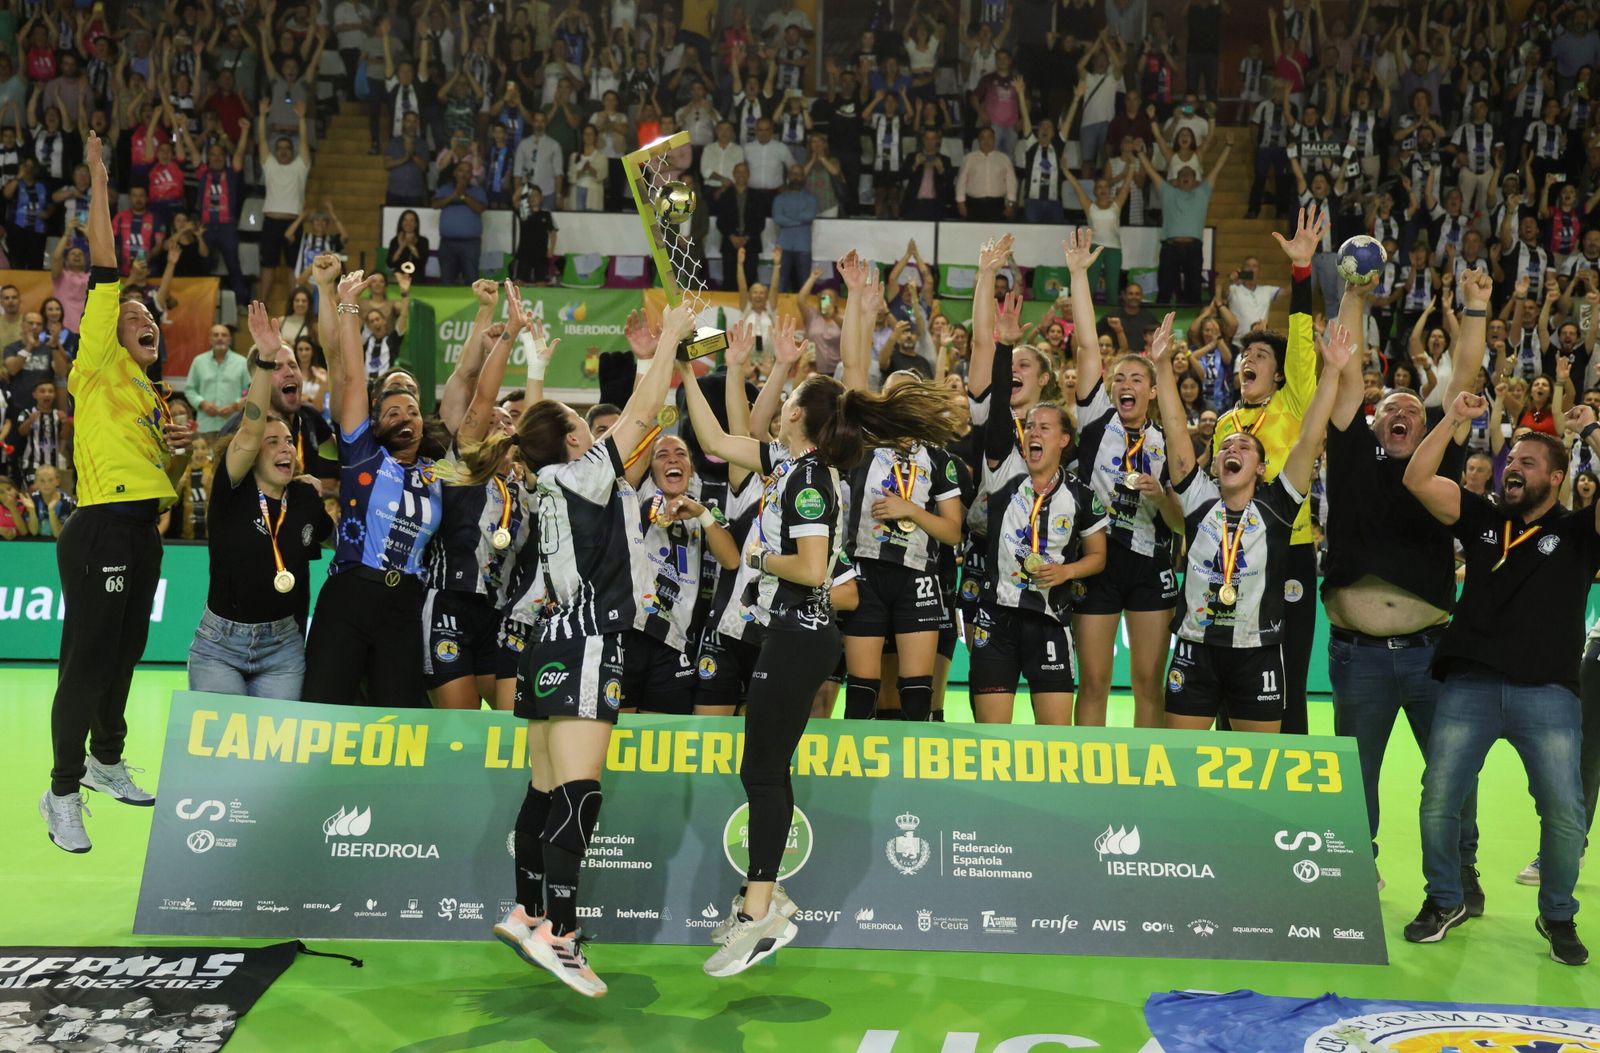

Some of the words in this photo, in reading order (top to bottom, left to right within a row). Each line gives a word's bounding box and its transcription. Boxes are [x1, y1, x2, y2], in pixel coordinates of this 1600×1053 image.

[501, 299, 544, 320] LGA
[565, 324, 625, 335] IBERDROL
[105, 575, 124, 592] 68
[915, 576, 934, 599] 22
[1046, 640, 1057, 662] 9
[539, 672, 570, 686] CSIF
[1262, 670, 1277, 692] 11
[188, 709, 428, 767] CAMPEÓN
[606, 729, 891, 778] GUERRAS
[903, 736, 1177, 787] IBERDROLA
[1195, 745, 1343, 793] 22/23
[589, 833, 636, 845] eración
[952, 831, 977, 841] Real
[331, 842, 440, 859] IBERDROLA
[584, 846, 624, 858] pañola
[952, 842, 1013, 854] Federación
[588, 858, 653, 870] Balonmano
[953, 855, 1003, 867] Española
[953, 867, 967, 877] de
[969, 867, 1033, 879] Balonmano
[1107, 861, 1216, 879] IBERDROLA
[213, 899, 244, 908] molten
[616, 908, 660, 919] helvetia
[794, 909, 842, 923] sacyr
[685, 918, 724, 928] Santand
[859, 922, 903, 931] IBERDROLA
[940, 921, 969, 930] Ceuta
[1031, 914, 1079, 934] renfe
[1092, 919, 1127, 932] AVIS
[1232, 926, 1274, 934] aquaservice
[1332, 927, 1365, 939] Gerflor
[54, 975, 224, 989] 2022/2023
